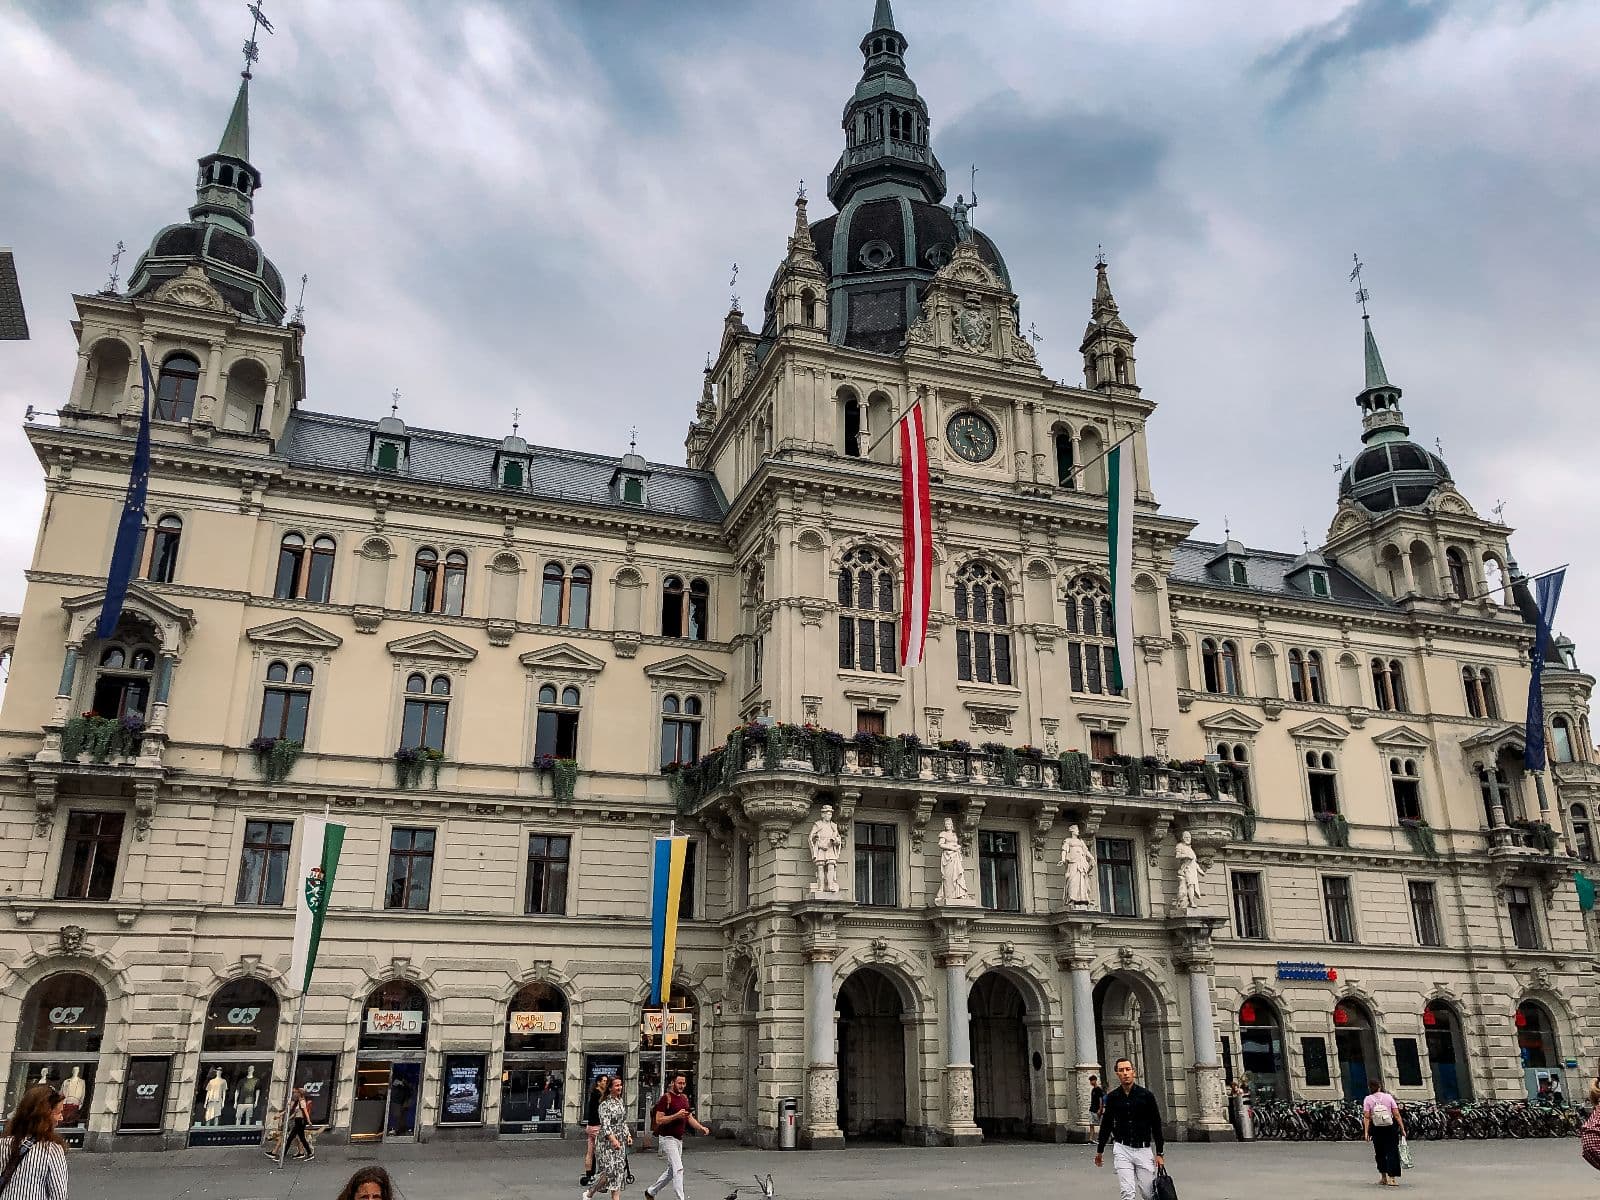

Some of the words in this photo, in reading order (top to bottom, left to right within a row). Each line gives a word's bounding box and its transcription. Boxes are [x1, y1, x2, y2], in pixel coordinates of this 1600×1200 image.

[373, 1012, 389, 1021] Red
[389, 1012, 403, 1021] Bull
[516, 1014, 530, 1022] Red
[530, 1014, 544, 1022] Bull
[649, 1015, 663, 1023] Red
[372, 1020, 417, 1031] WORLD
[515, 1021, 556, 1031] WORLD
[649, 1022, 688, 1032] WRLD
